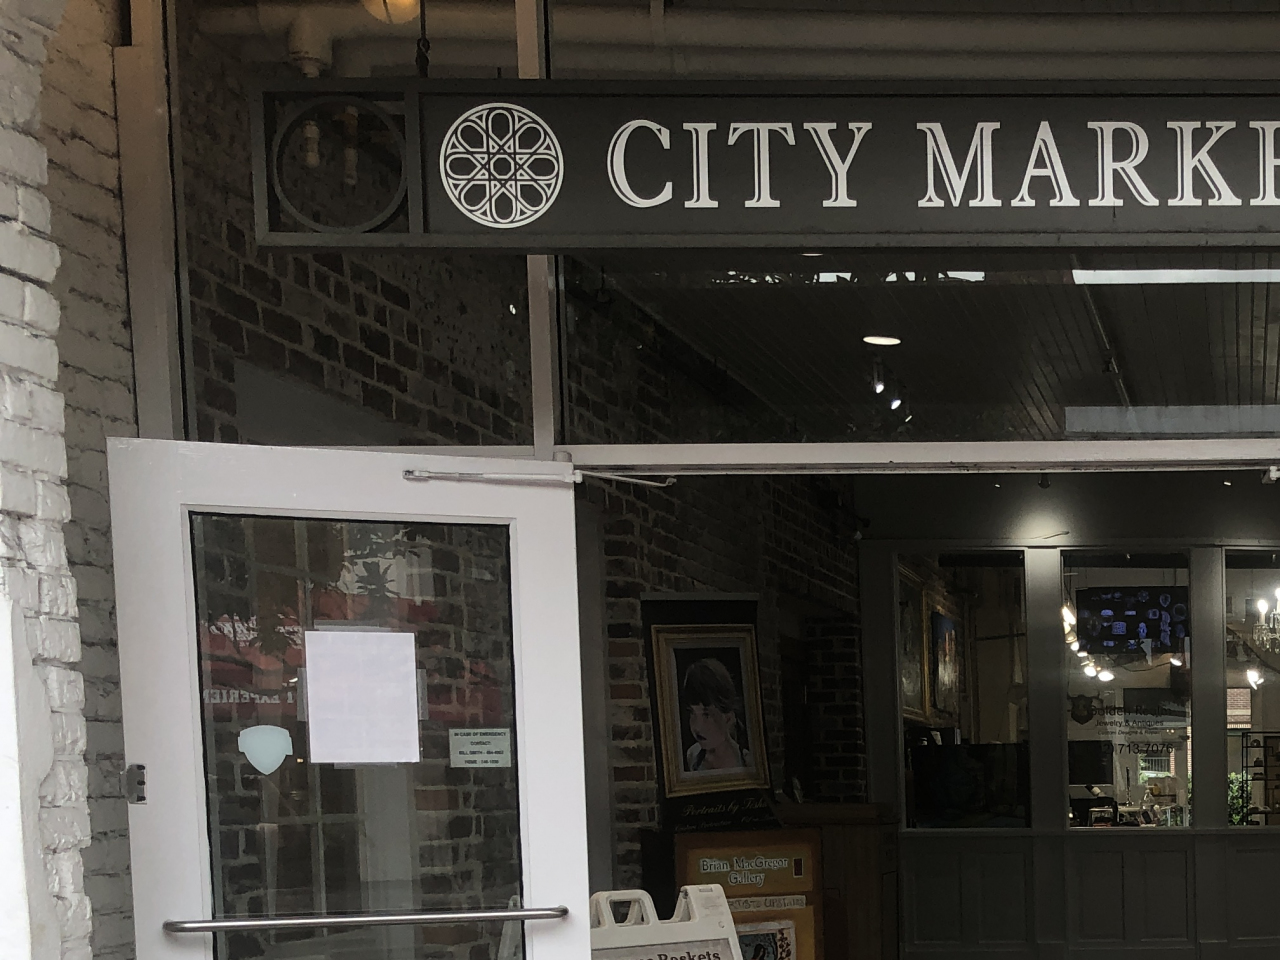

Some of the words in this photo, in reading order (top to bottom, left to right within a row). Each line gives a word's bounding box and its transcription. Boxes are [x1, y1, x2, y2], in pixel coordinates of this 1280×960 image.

[607, 119, 872, 208] CITY
[1095, 719, 1123, 728] Jewelry
[1132, 719, 1164, 728] Antiques
[680, 803, 726, 817] Portraits
[727, 800, 739, 814] by
[702, 858, 730, 871] Brian
[734, 856, 788, 870] MacGregor
[728, 872, 765, 886] Gallery
